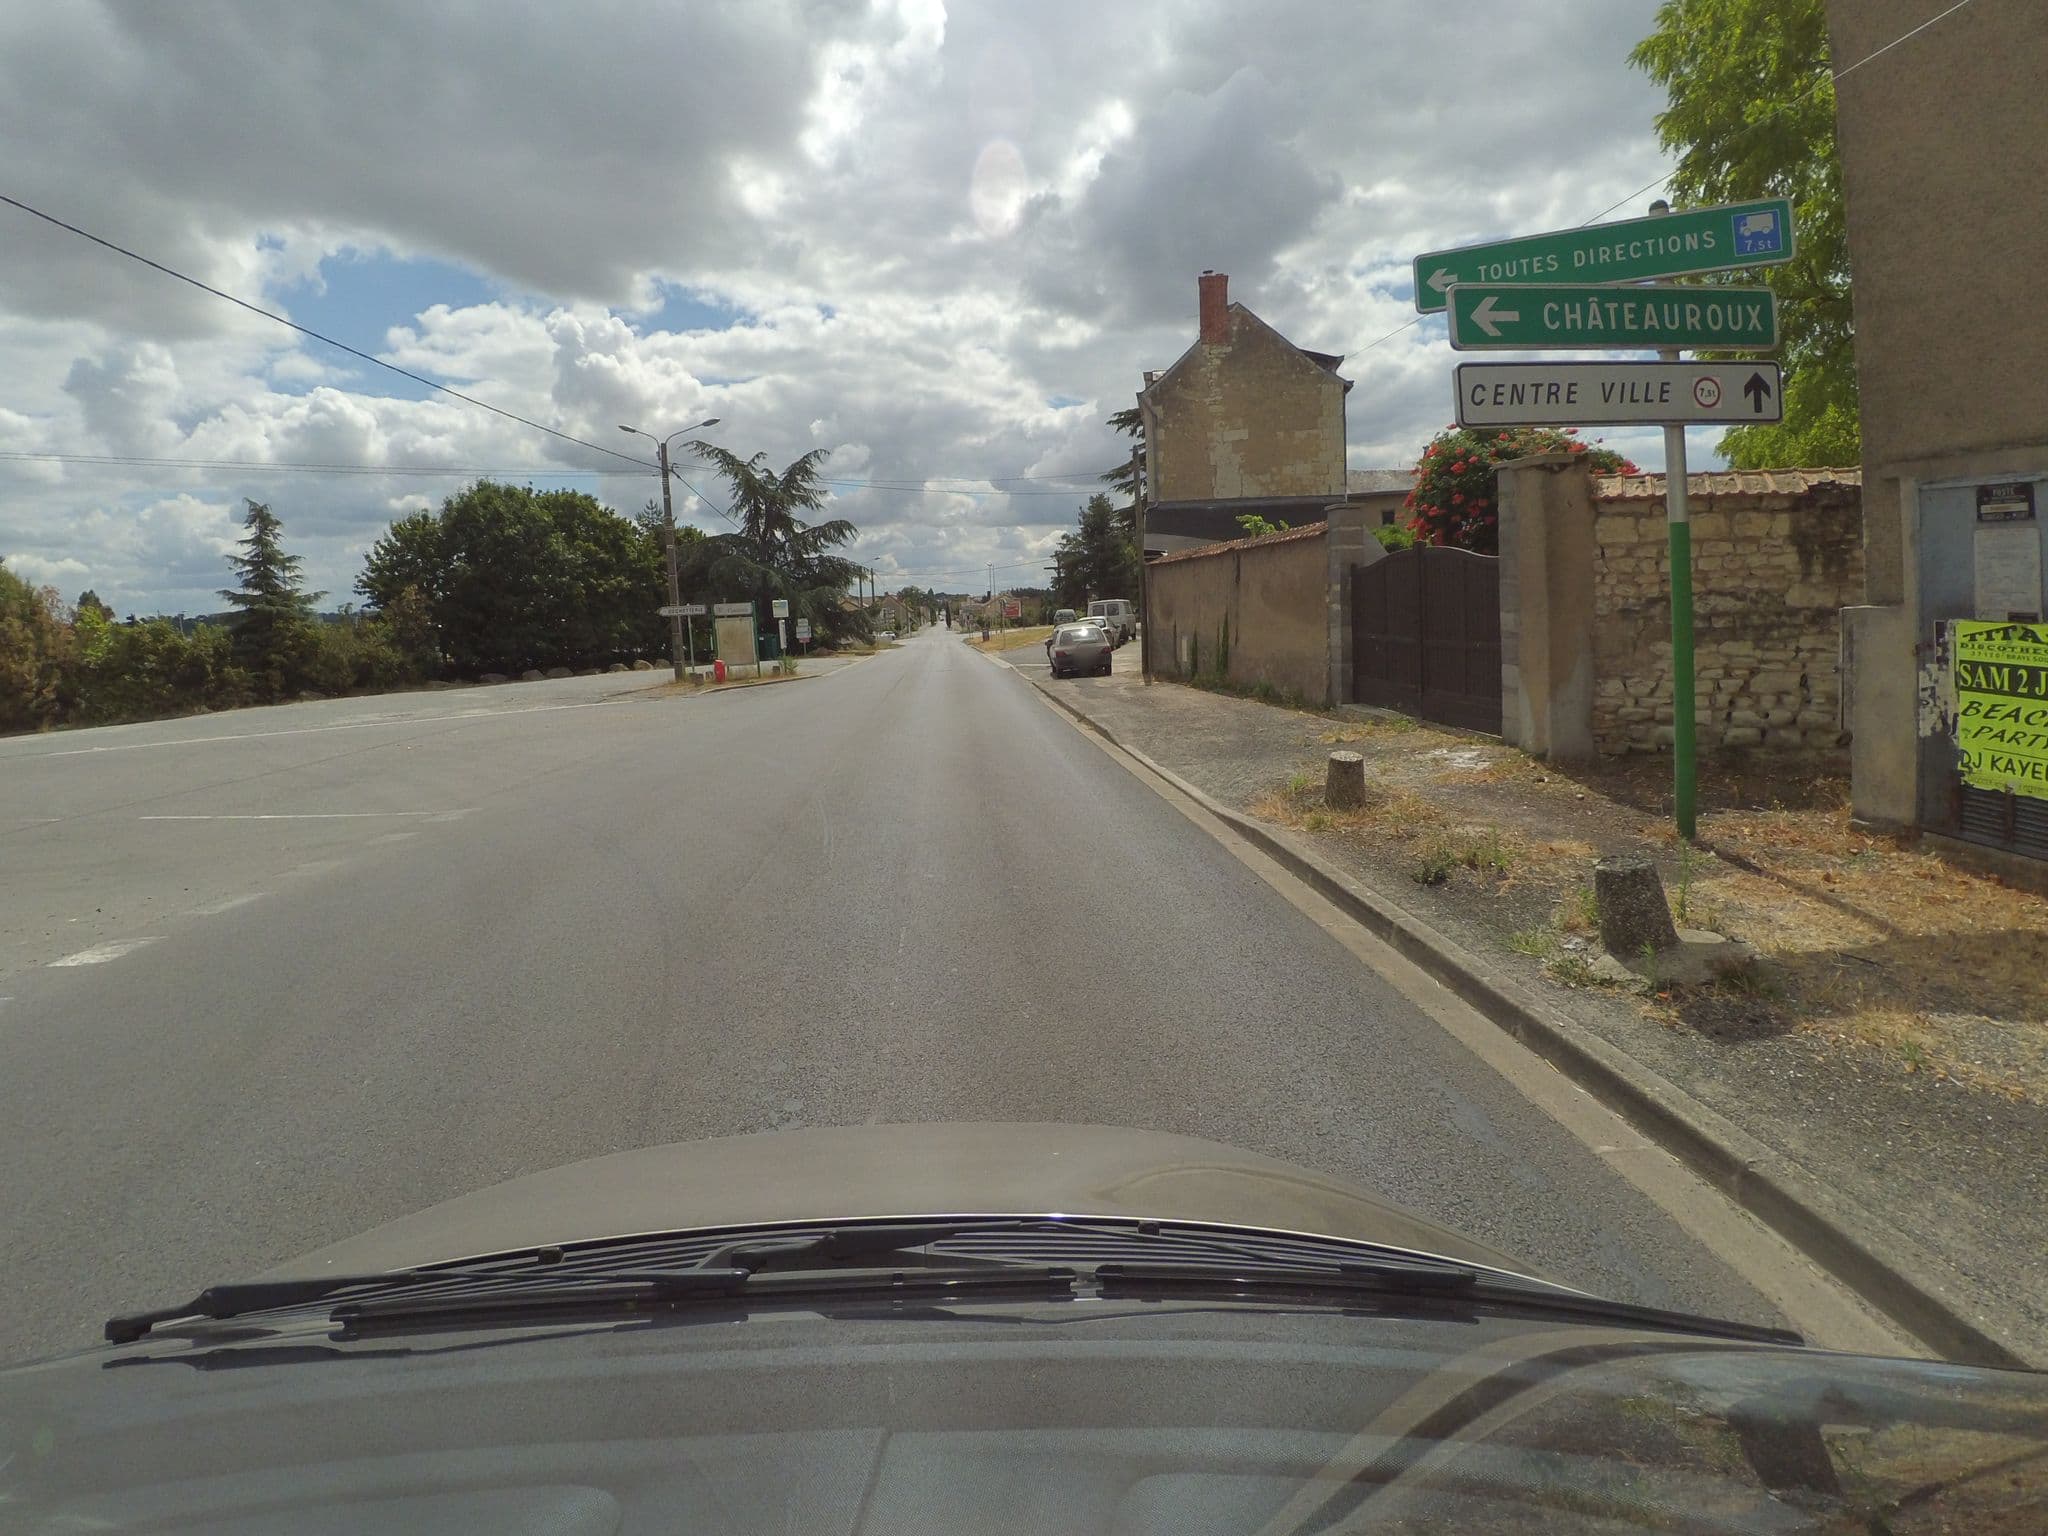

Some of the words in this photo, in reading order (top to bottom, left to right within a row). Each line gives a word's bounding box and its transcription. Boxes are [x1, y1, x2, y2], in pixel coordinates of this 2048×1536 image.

[1478, 254, 1559, 281] TOUTES
[1573, 231, 1716, 268] DIRECTIONS
[1543, 297, 1763, 332] CHÂTEAUROUX
[1470, 382, 1578, 407] CENTRE
[1601, 381, 1671, 404] VILLE
[1962, 625, 2048, 645] TITA
[1960, 664, 2011, 691] SAM
[2017, 668, 2029, 693] 2
[1960, 749, 1982, 769] DJ
[1990, 754, 2048, 782] KAYE
